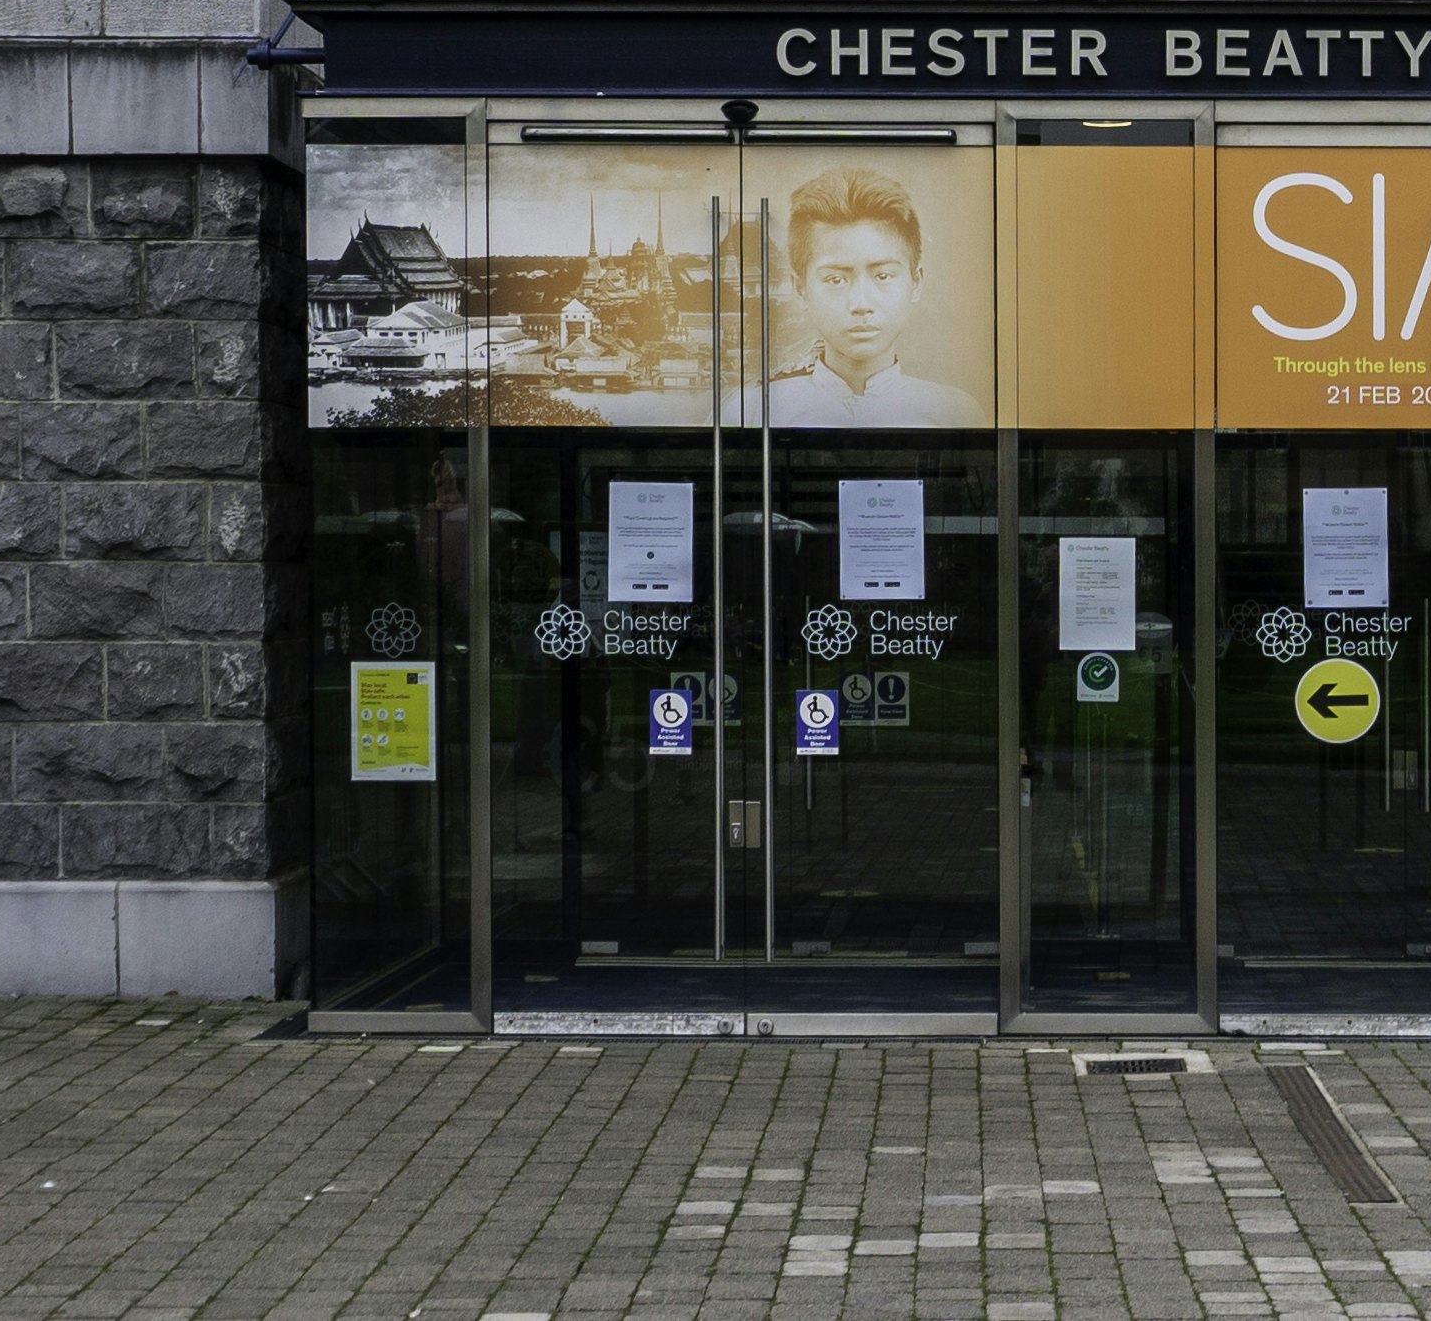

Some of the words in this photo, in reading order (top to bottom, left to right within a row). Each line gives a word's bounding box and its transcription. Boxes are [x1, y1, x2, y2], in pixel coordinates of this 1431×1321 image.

[776, 28, 1108, 77] CHESTER
[1273, 357, 1350, 377] Through
[1354, 357, 1385, 374] the
[1389, 357, 1428, 374] lens
[1326, 385, 1351, 405] 21
[1359, 385, 1401, 405] FEB
[603, 610, 692, 631] Chester
[870, 610, 958, 631] Chester
[1324, 611, 1412, 633] Chester
[604, 634, 678, 660] Beatty
[871, 634, 944, 660] Beatty
[1325, 635, 1399, 661] Beatty
